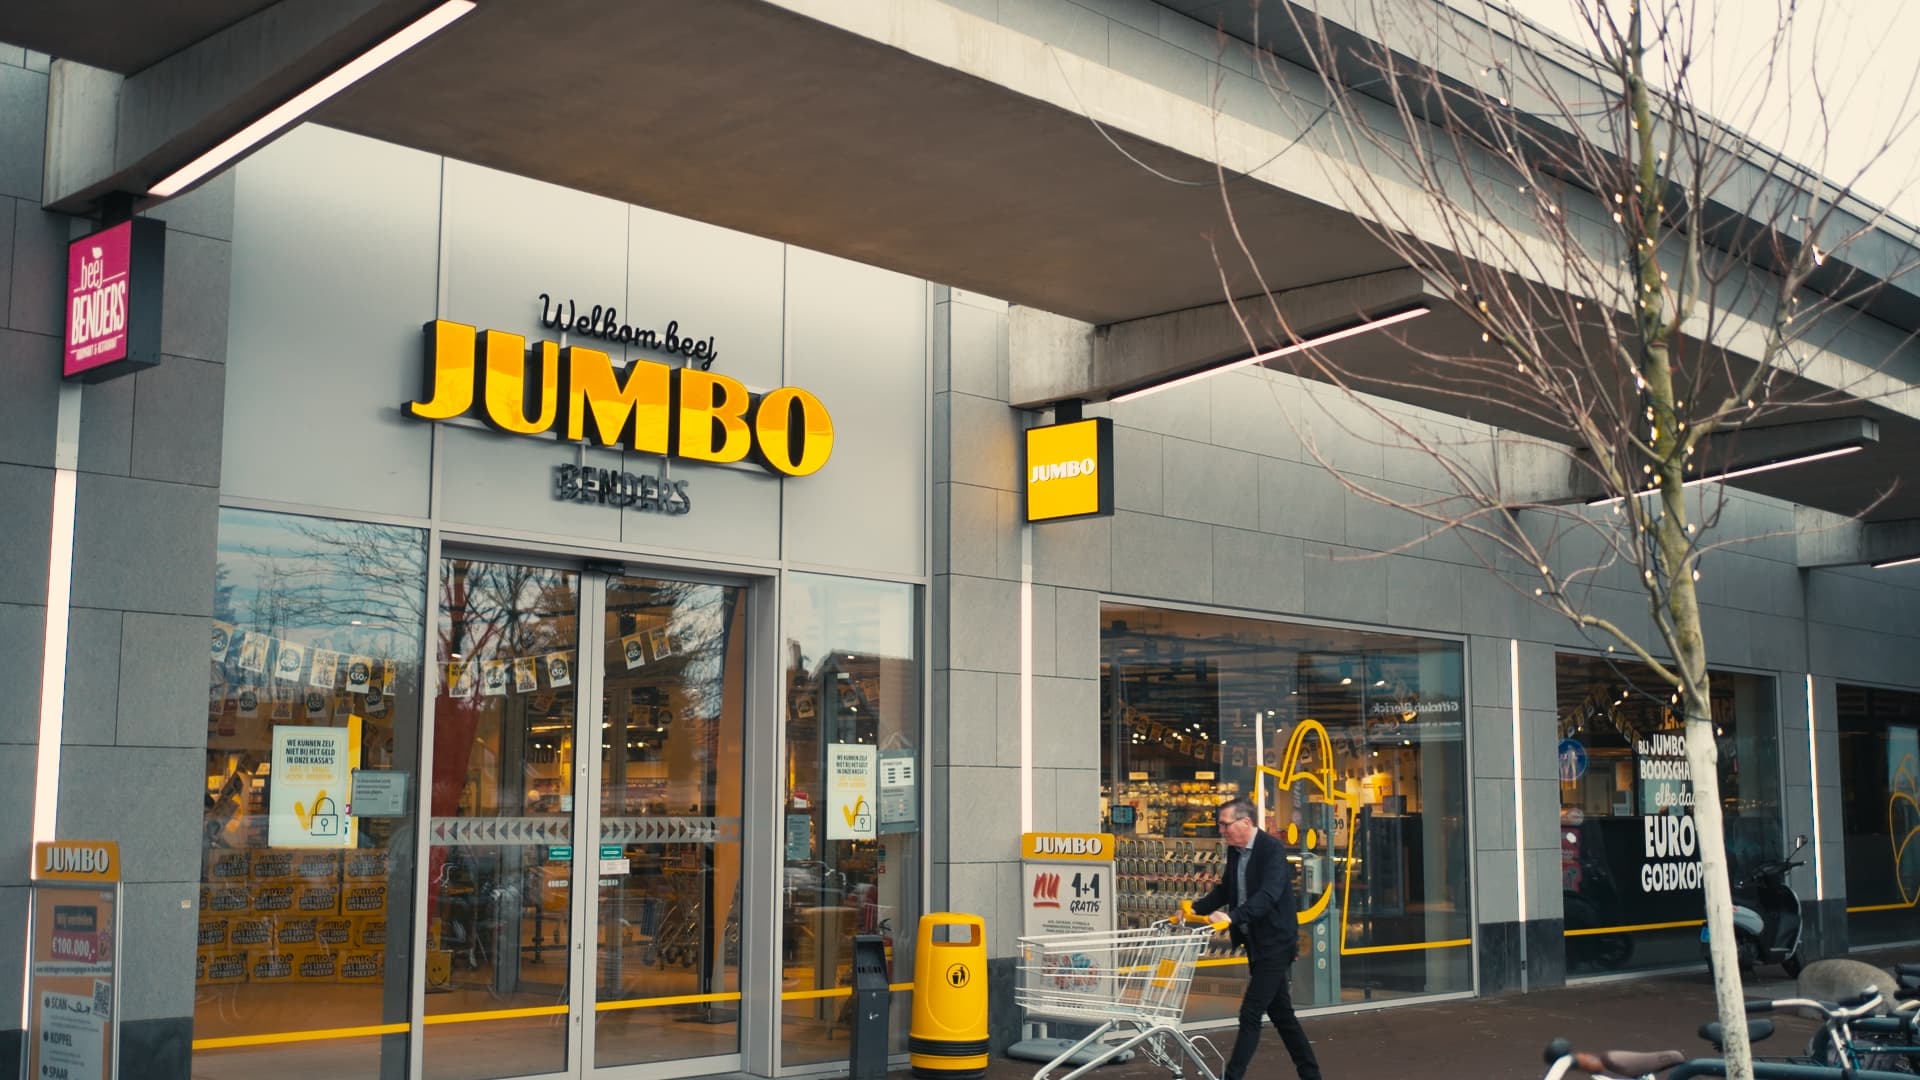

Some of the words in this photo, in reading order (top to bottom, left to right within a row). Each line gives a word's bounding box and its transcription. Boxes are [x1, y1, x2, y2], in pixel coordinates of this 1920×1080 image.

[80, 248, 104, 290] beej
[71, 280, 126, 346] BENDERS
[537, 293, 662, 350] Welkom
[663, 320, 718, 371] beej
[407, 318, 835, 478] JUMBO
[1030, 458, 1096, 484] JUMBO
[555, 462, 692, 516] BENDERS
[286, 748, 299, 756] NIET
[300, 748, 309, 756] BIJ
[310, 748, 320, 756] HET
[287, 739, 296, 747] WE
[297, 739, 321, 747] KUNNEN
[1638, 740, 1649, 755] BIJ
[1650, 734, 1687, 757] JUMBO
[310, 757, 334, 765] KASSA'S
[1640, 760, 1691, 781] BOODSCHA
[1655, 782, 1678, 806] elke
[1033, 836, 1103, 855] JUMBO
[44, 847, 110, 873] JUMBO
[1071, 872, 1100, 899] 1+1
[1641, 861, 1704, 893] GOEDKOP
[1069, 900, 1101, 914] GRATIS
[52, 936, 96, 960] €100.000,-
[51, 997, 68, 1011] SCAN
[50, 1031, 73, 1047] KOPPEL
[48, 1065, 69, 1079] SPAAR
